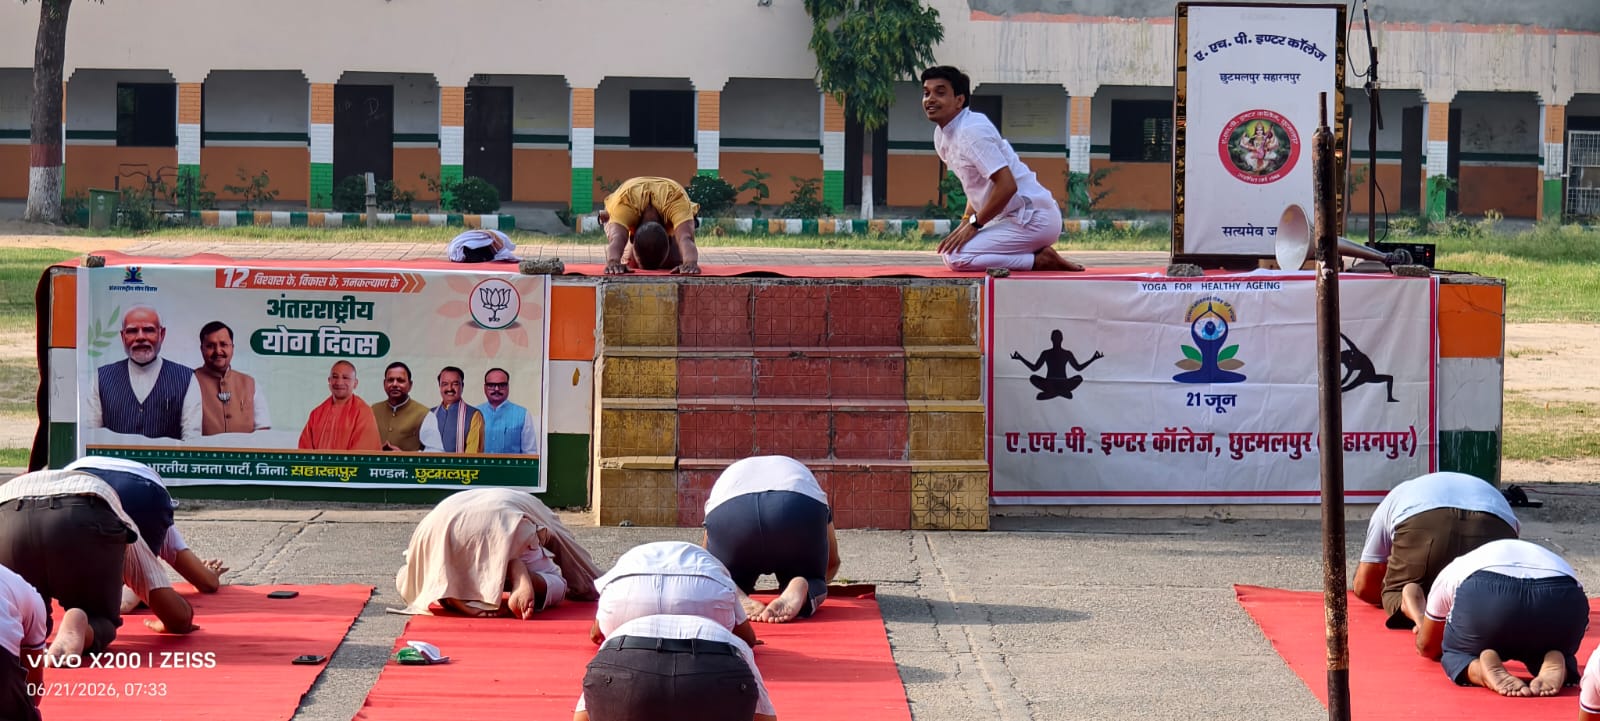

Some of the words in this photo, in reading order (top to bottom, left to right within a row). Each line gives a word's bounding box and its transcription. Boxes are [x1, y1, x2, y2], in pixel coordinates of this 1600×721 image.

[1193, 50, 1208, 61] ए.
[1208, 39, 1232, 53] एच.
[1234, 31, 1252, 45] पी.
[1255, 34, 1287, 45] इण्टर
[1287, 38, 1327, 62] कॉलेज
[1219, 73, 1260, 84] छुटमलपुर
[1262, 73, 1301, 84] सहारनपुर
[1221, 222, 1264, 237] सत्यमेव
[223, 267, 250, 288] 12
[253, 272, 286, 286] विश्वास
[286, 273, 297, 287] के,
[299, 274, 328, 288] विकास
[328, 274, 339, 288] के,
[341, 277, 388, 289] जनकल्याण
[390, 275, 401, 288] के
[1142, 283, 1167, 291] YOGA
[1174, 283, 1192, 291] FOR
[1201, 282, 1241, 290] HEALTHY
[1246, 281, 1280, 290] AGEING
[266, 293, 375, 324] अंतरराष्ट्रीय
[261, 325, 313, 354] योग
[317, 326, 380, 355] दिवस
[1186, 392, 1201, 406] 21
[1203, 394, 1238, 414] जून
[1100, 432, 1147, 456] इण्टर
[1152, 427, 1220, 457] कॉलेज,
[1228, 432, 1313, 460] छुटमलपुर
[1316, 425, 1418, 460] हारनपुर)
[190, 462, 223, 475] जनता
[226, 462, 253, 476] पार्टी,
[256, 463, 289, 476] जिला:
[369, 467, 408, 479] मण्डल:
